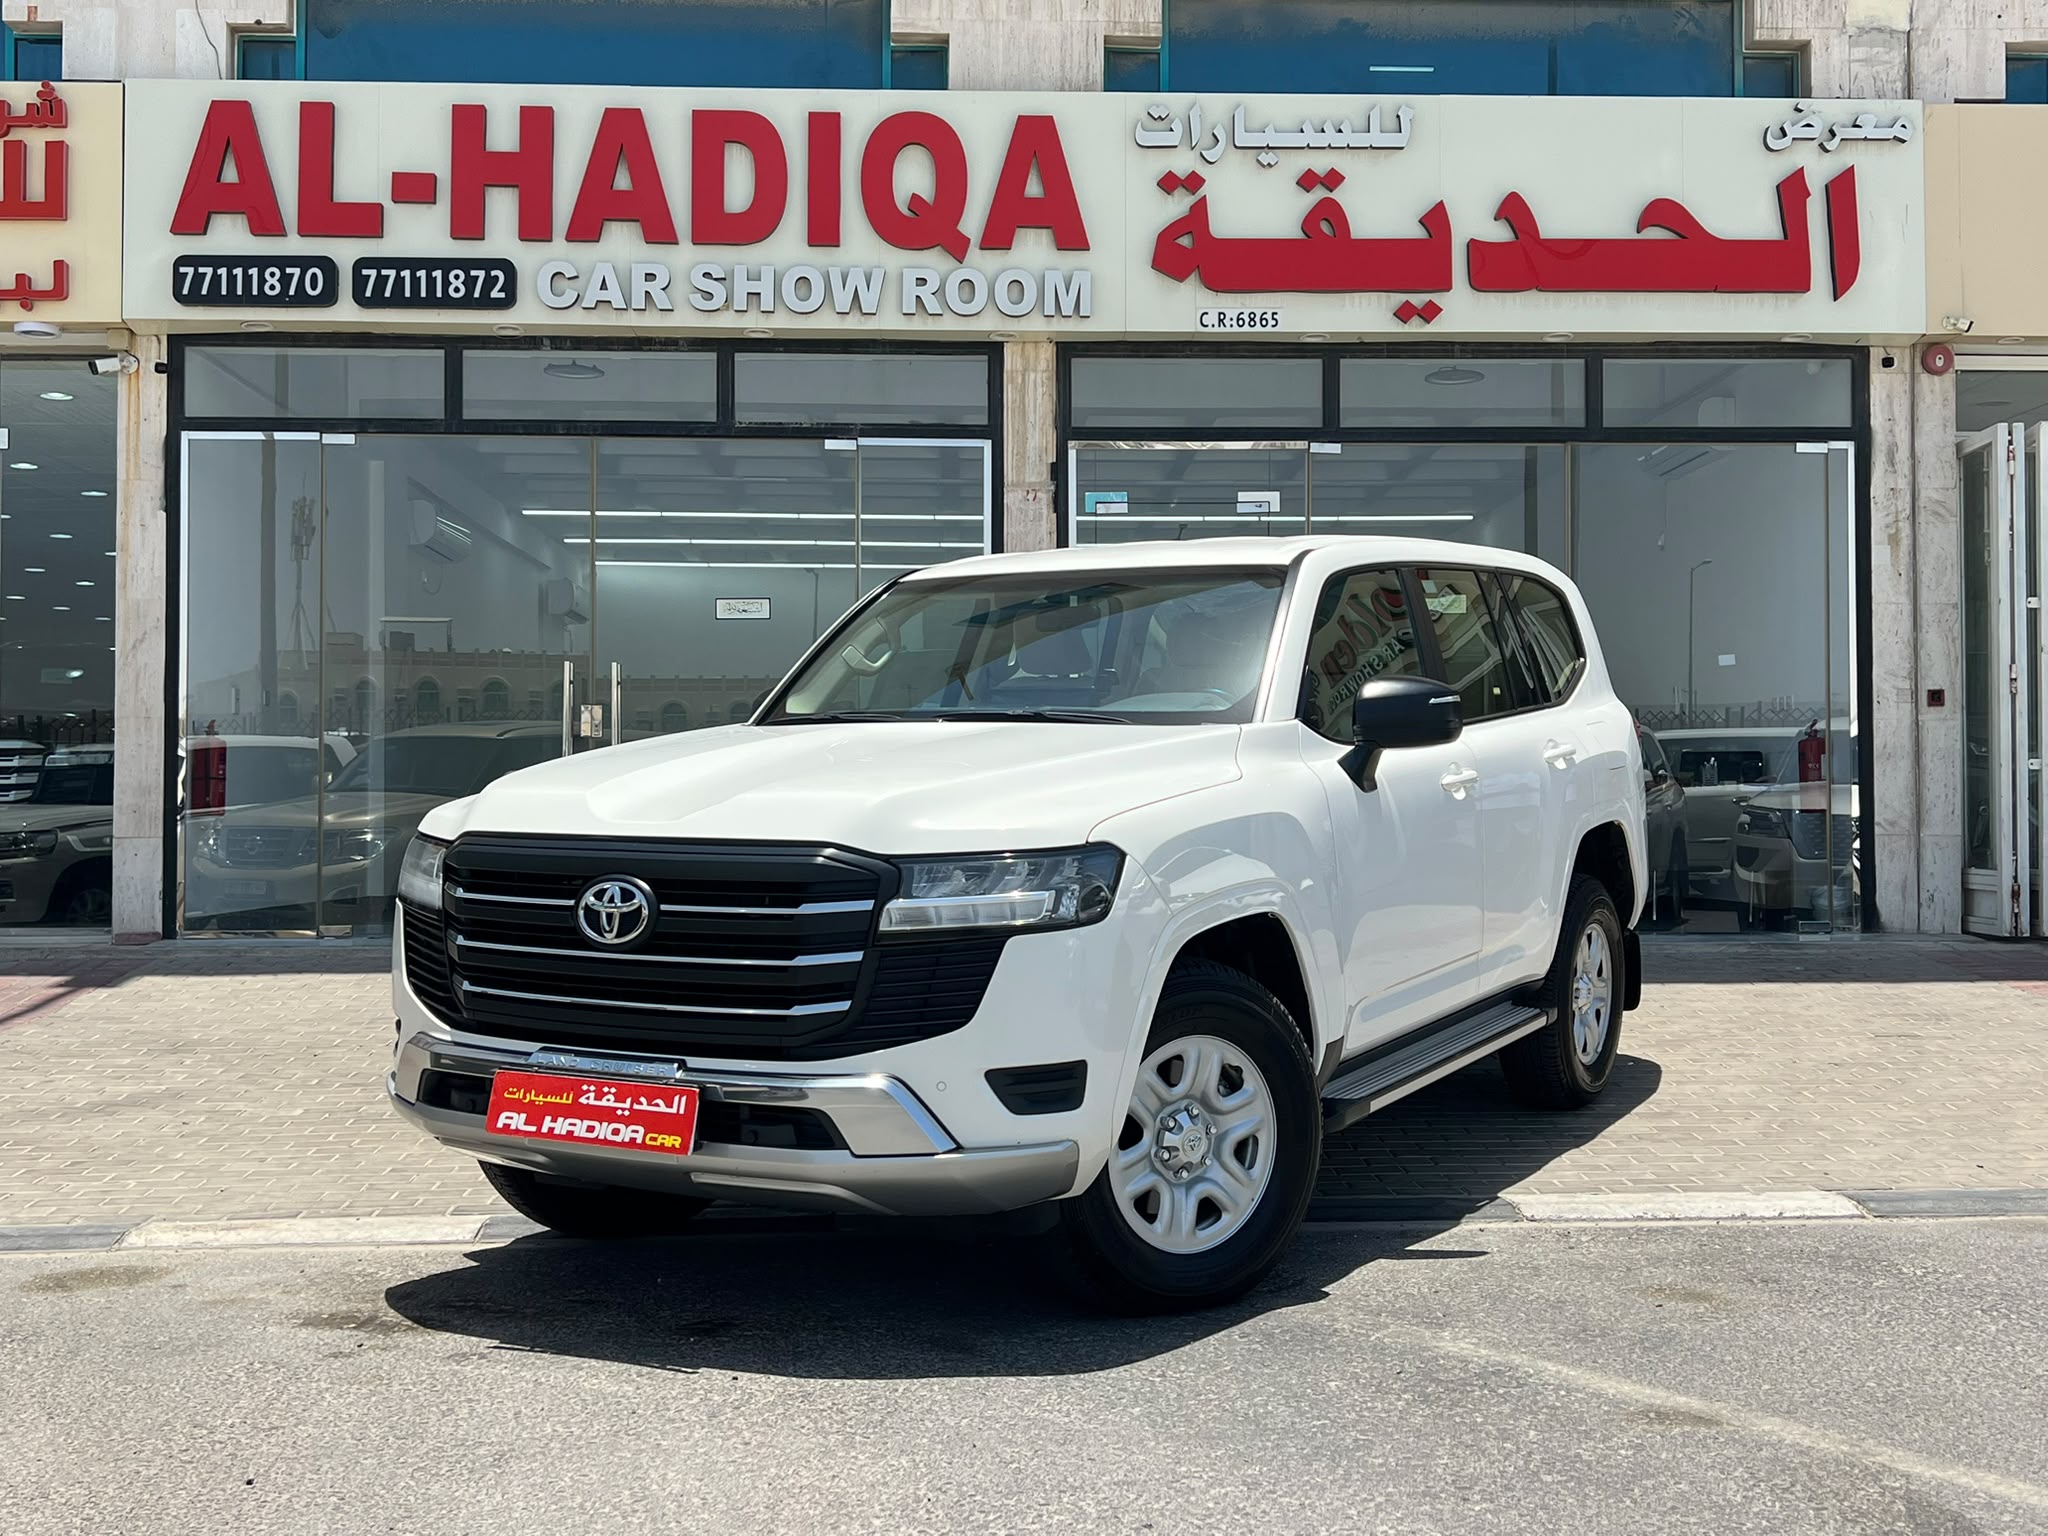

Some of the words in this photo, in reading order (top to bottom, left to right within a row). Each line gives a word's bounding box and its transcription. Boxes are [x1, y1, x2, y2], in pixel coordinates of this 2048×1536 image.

[1134, 102, 1415, 168] للسيارات
[1763, 101, 1914, 153] معرض
[169, 99, 1091, 264] AL-HADIQA
[1150, 164, 1862, 325] الحديقة
[178, 266, 325, 297] 77111870
[361, 267, 506, 300] 77111872
[536, 260, 674, 312] CAR
[688, 263, 886, 316] SHOW
[901, 267, 1093, 319] ROOM
[1199, 311, 1279, 328] C.R:6865
[536, 1053, 580, 1068] LAND
[503, 1086, 574, 1105] للسيارات
[577, 1083, 687, 1116] الحديقة
[496, 1111, 538, 1133] AL
[540, 1115, 646, 1144] HADIQA
[645, 1133, 683, 1149] CAR
